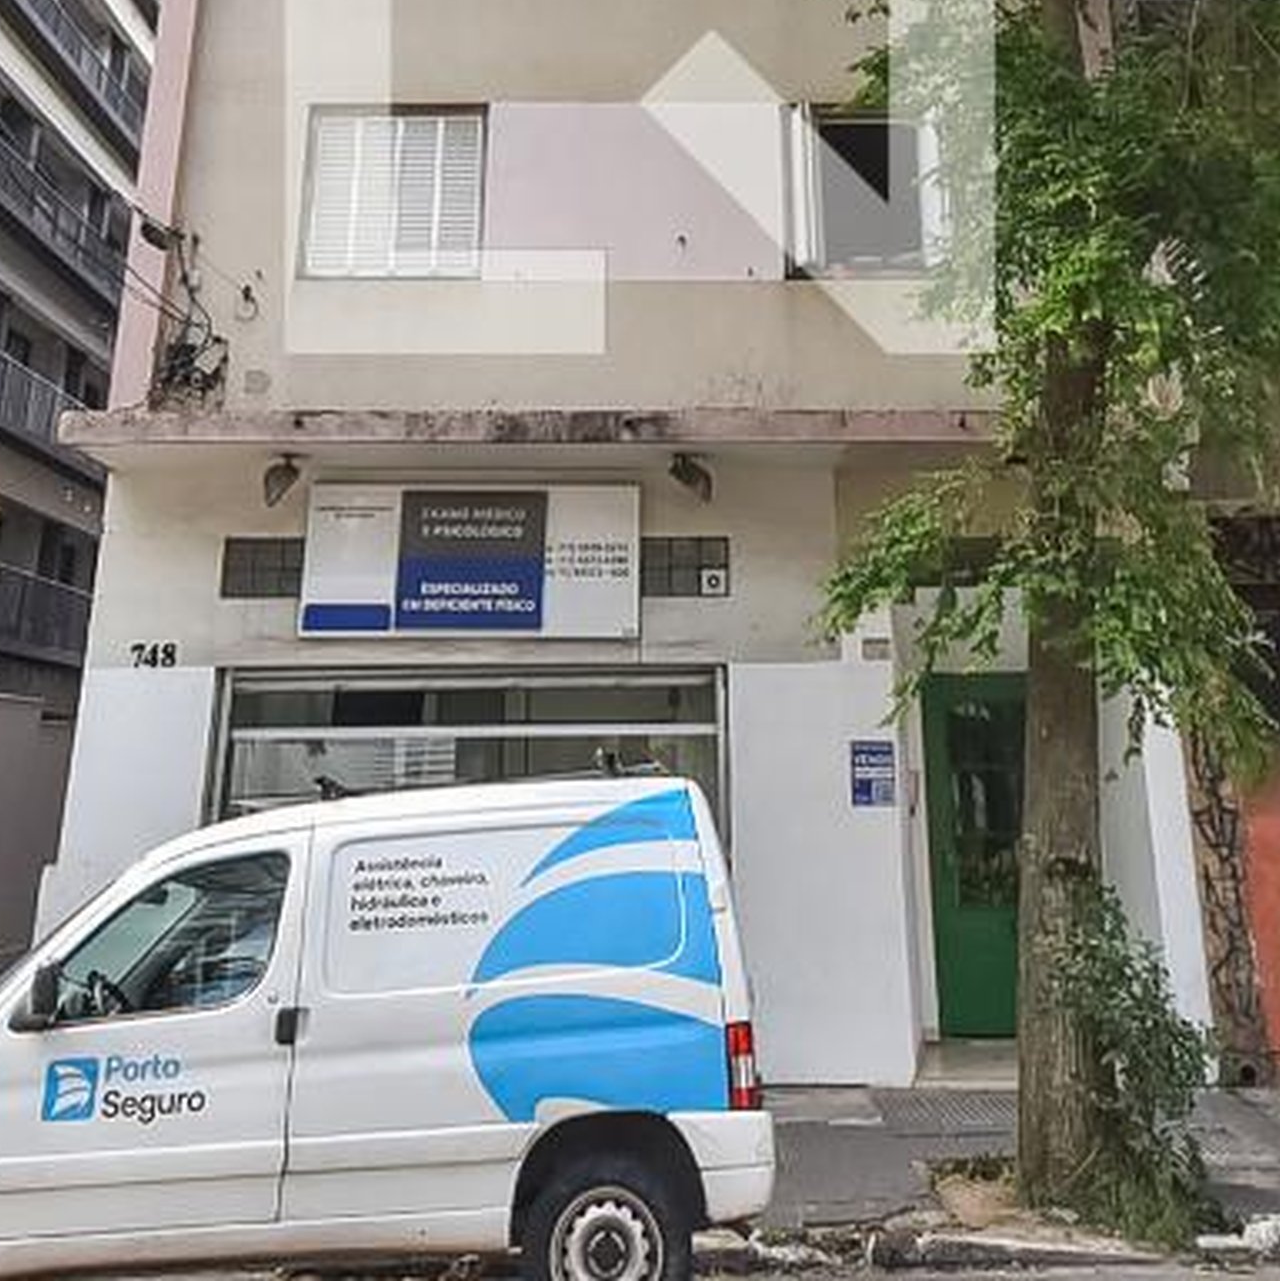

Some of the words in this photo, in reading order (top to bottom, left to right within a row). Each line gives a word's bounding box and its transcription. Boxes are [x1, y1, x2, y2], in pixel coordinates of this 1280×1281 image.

[421, 582, 520, 595] ESPECIALIZADO
[423, 599, 493, 612] DEFICIENTE
[130, 643, 177, 668] 748
[353, 856, 443, 874] Assistência
[353, 873, 416, 892] elétrica,
[420, 870, 490, 888] chaveiro,
[350, 893, 428, 912] hidráulica
[431, 895, 442, 908] e
[349, 911, 489, 932] eletrodomésticos
[105, 1054, 180, 1082] Porto
[101, 1089, 206, 1125] Seguro
